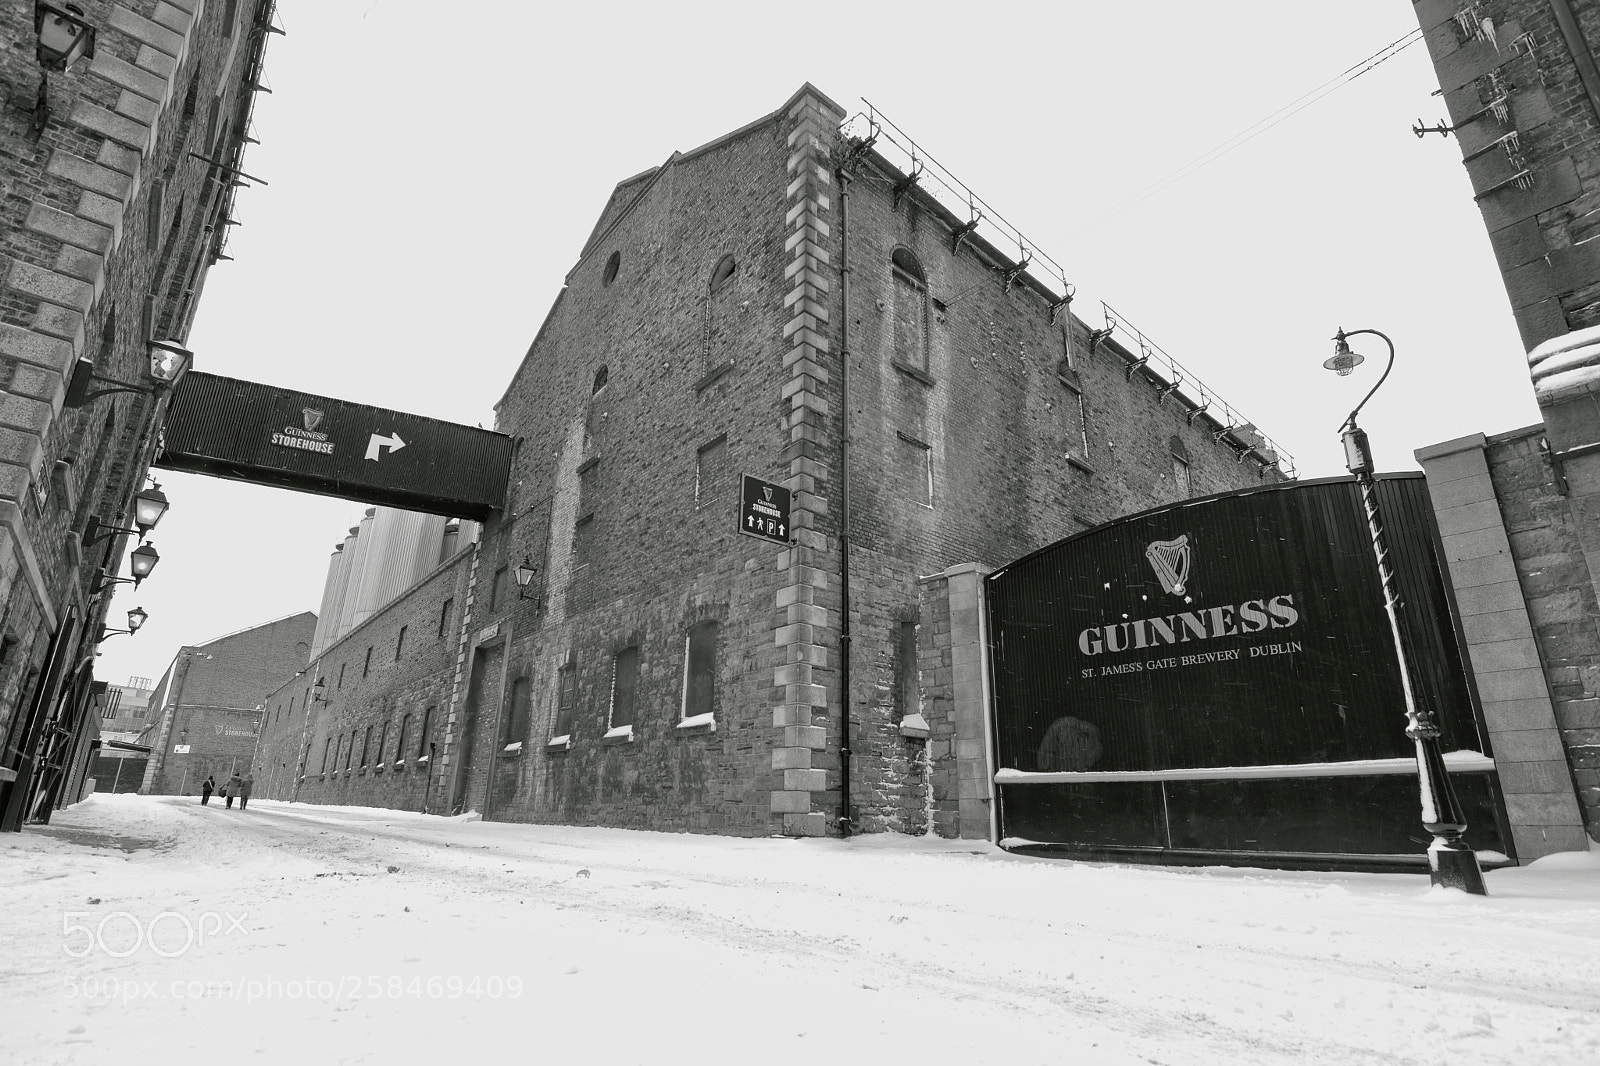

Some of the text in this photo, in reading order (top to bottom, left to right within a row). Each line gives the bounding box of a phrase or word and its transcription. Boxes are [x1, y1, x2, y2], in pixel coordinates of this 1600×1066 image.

[272, 434, 334, 454] STOREHOUSE
[284, 427, 328, 441] GUINNESS
[769, 522, 774, 532] P
[1078, 594, 1299, 656] GUINNESS
[1081, 641, 1303, 679] ST. JAMES'S GATE BREWERY DUBLIN
